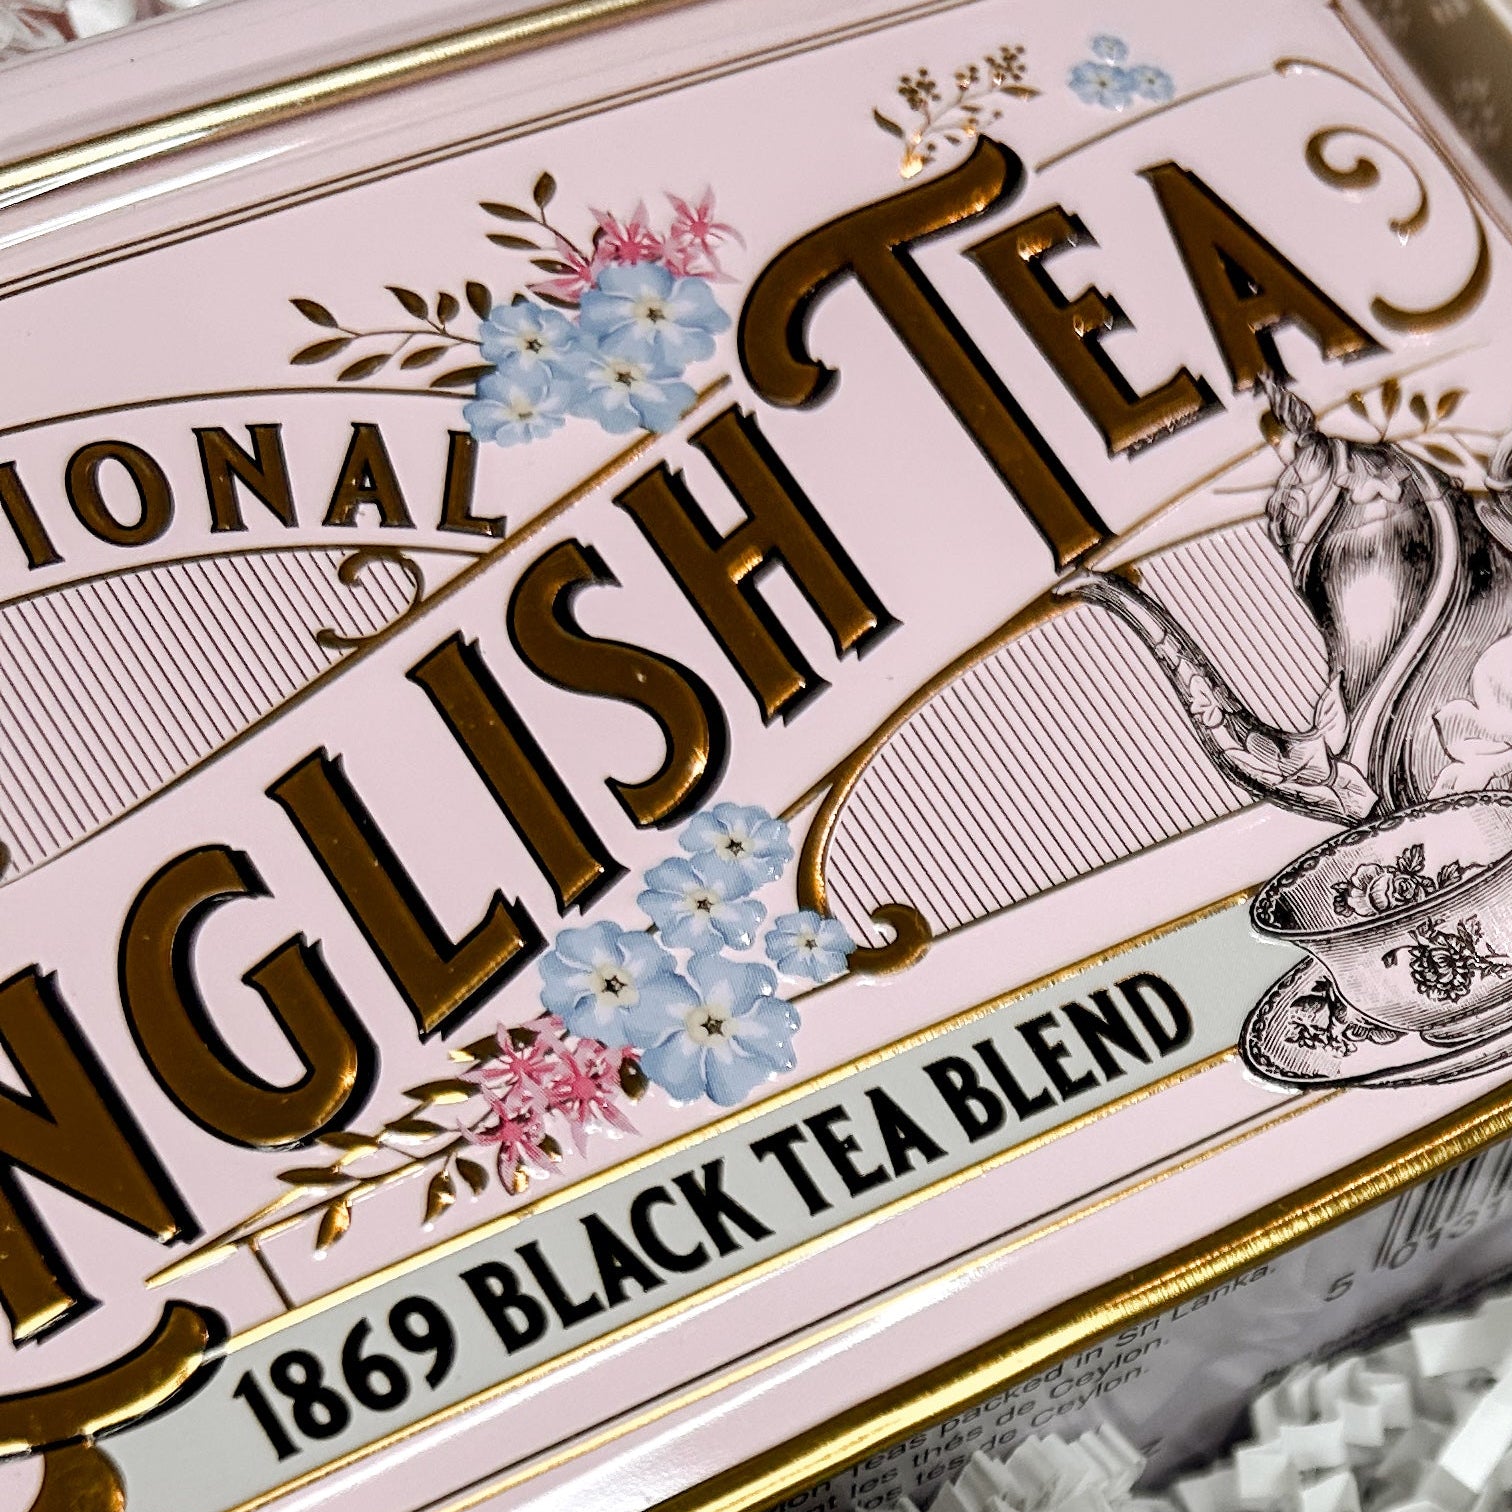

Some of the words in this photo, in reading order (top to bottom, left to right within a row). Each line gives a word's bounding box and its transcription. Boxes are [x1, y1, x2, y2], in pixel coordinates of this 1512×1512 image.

[0, 422, 507, 571] IONAL
[0, 404, 904, 1347] NGLISH
[736, 133, 1390, 574] TEA
[231, 1299, 457, 1464] 1869
[459, 1159, 775, 1355] BLACK
[756, 1100, 949, 1219] TEA
[923, 970, 1194, 1143] BLEND
[1324, 1271, 1355, 1303] 5
[851, 1466, 898, 1496] les
[913, 1425, 984, 1467] thés
[996, 1401, 1036, 1427] de
[1049, 1336, 1169, 1399] Ceylon.
[940, 1362, 1064, 1434] packed
[1075, 1346, 1103, 1369] in
[1118, 1315, 1160, 1346] Sri
[1031, 1365, 1149, 1428] Ceylon.
